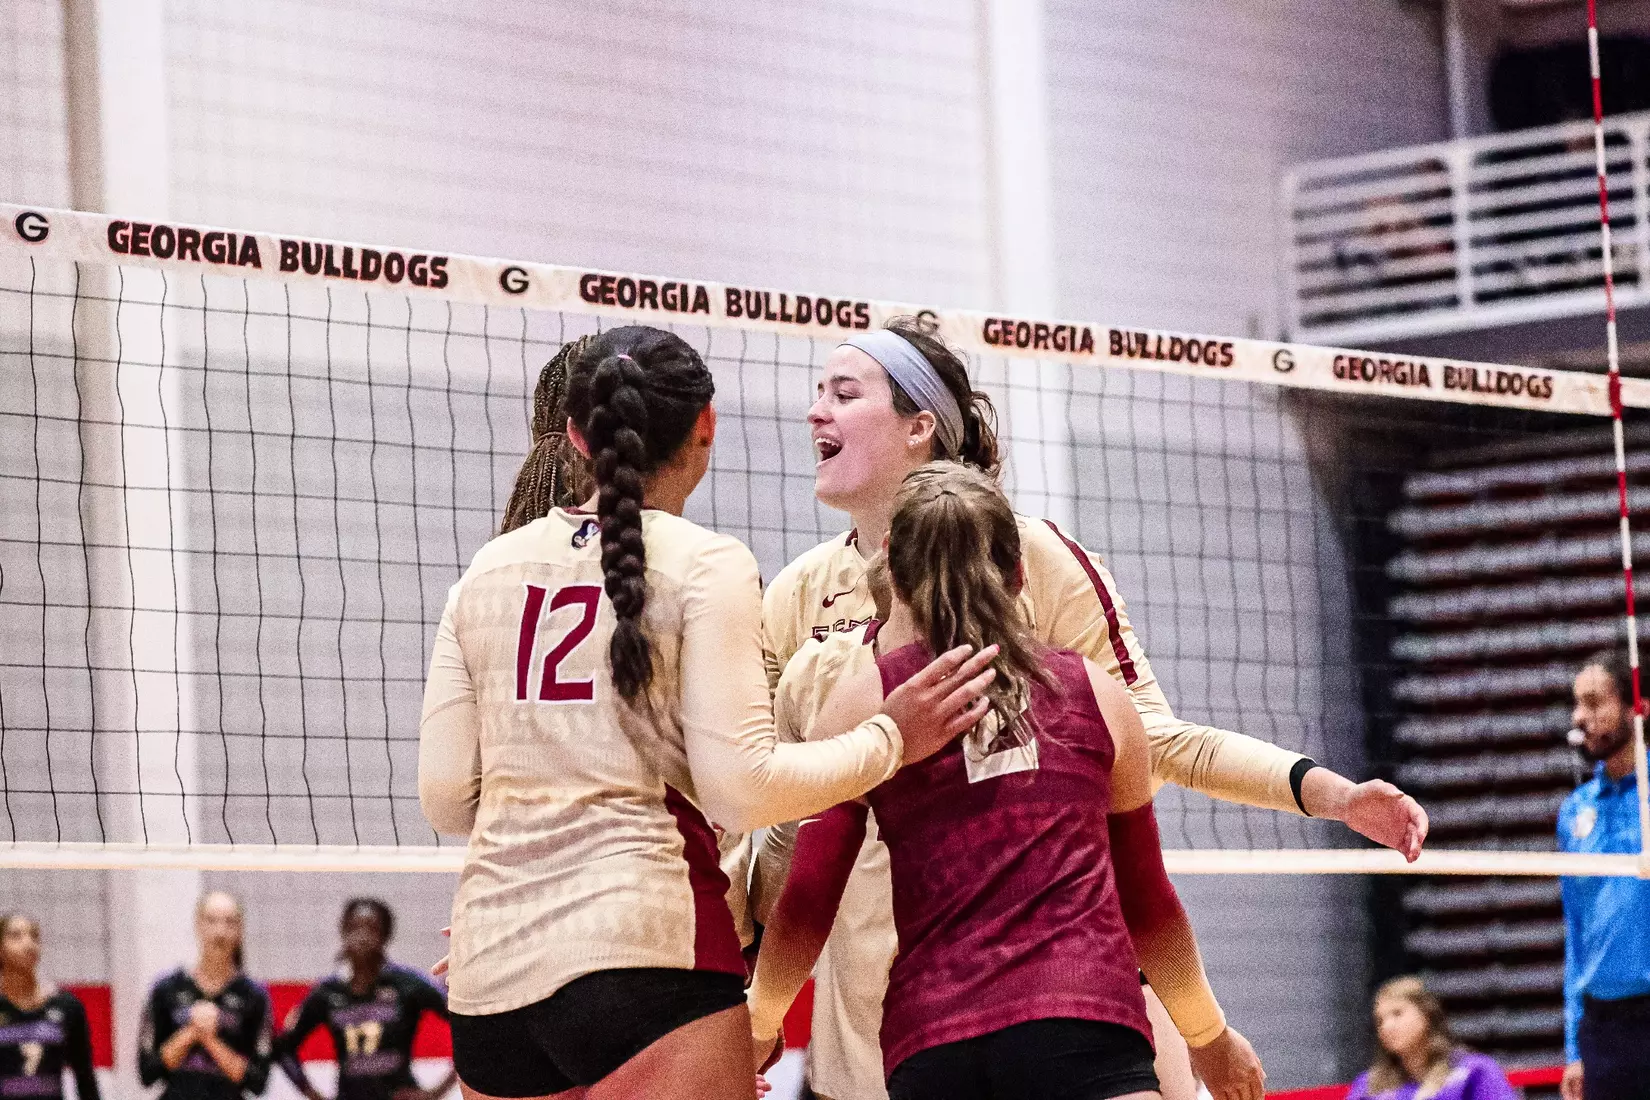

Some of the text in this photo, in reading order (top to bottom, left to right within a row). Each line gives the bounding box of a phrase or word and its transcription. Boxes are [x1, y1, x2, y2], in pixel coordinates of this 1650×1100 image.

[14, 211, 49, 243] G
[107, 220, 449, 289] GEORGIA BULLDOGS
[499, 266, 530, 295] G
[579, 273, 870, 330] GEORGIA BULLDOGS
[983, 318, 1234, 367] GEORGIA BULLDOGS
[1273, 349, 1296, 373] G
[1333, 354, 1553, 400] GEORGIA BULLDOGS
[515, 583, 602, 703] 12
